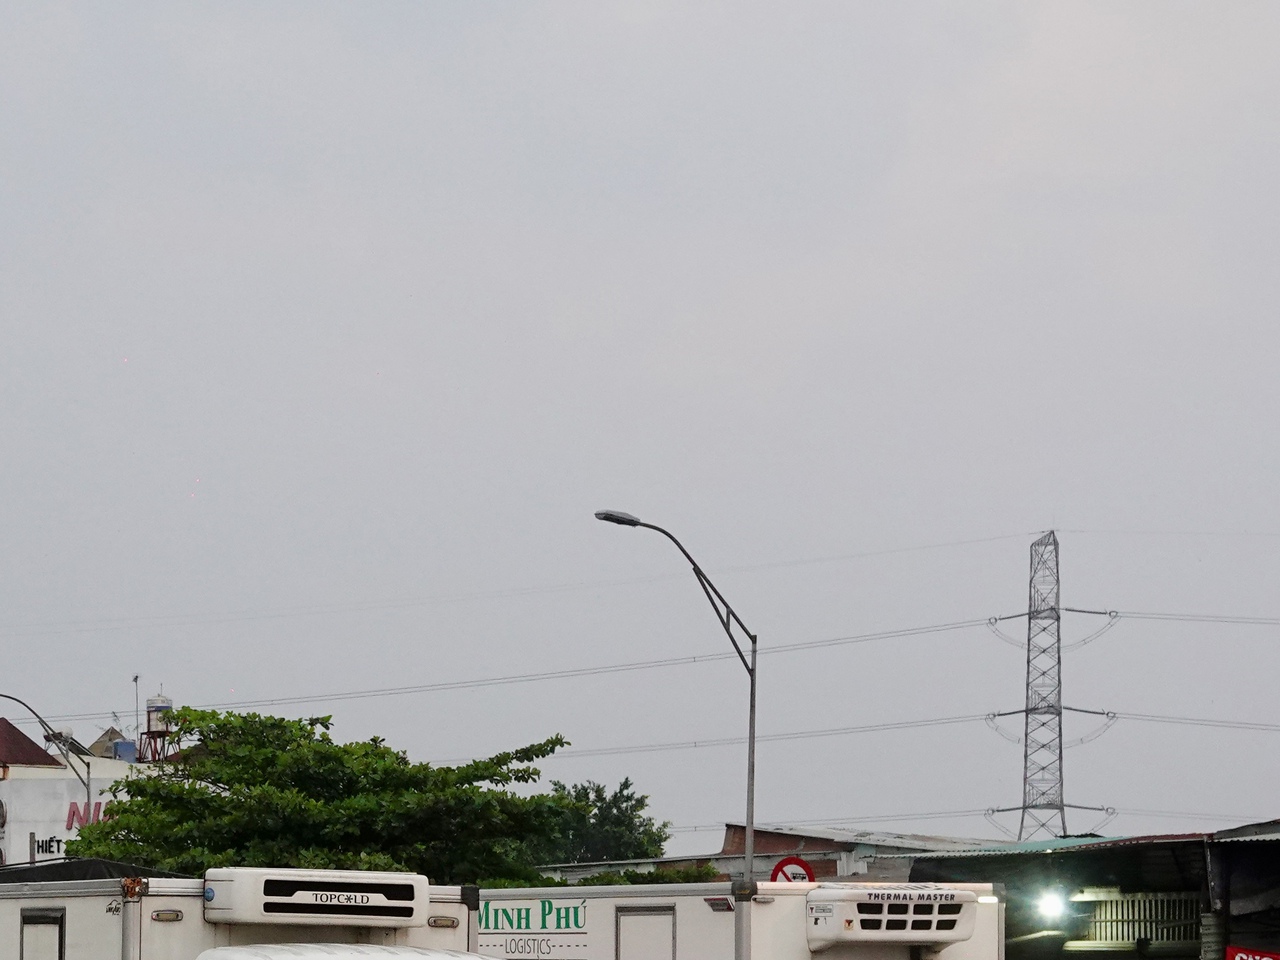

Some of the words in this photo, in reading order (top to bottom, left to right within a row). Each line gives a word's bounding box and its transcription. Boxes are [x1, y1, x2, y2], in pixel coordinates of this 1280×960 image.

[35, 836, 63, 855] HIẾT
[867, 893, 914, 901] THERMAL
[918, 893, 956, 902] MASTER
[539, 899, 588, 930] PHÚ
[505, 938, 552, 954] LOGISTICS
